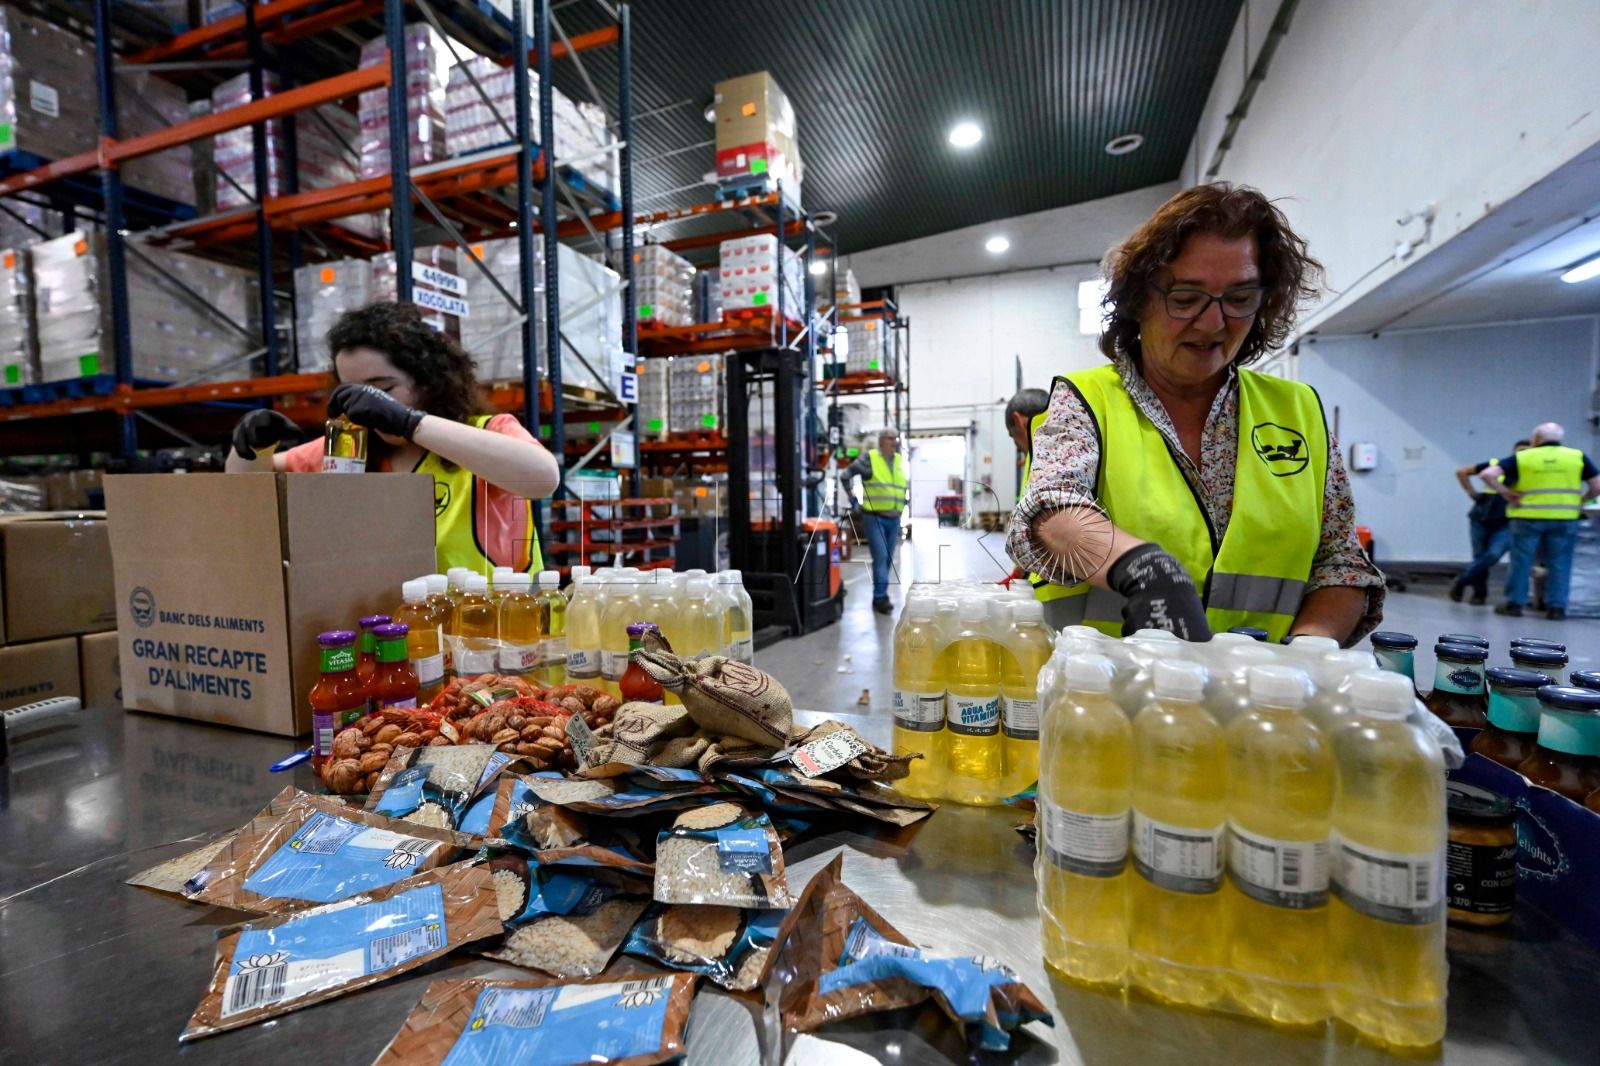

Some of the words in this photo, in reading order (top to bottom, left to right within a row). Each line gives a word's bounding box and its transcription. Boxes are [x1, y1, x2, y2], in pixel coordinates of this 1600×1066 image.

[417, 290, 466, 315] XOCOLATA
[620, 375, 635, 399] E
[159, 611, 186, 625] BANC
[188, 613, 212, 628] DELS
[213, 616, 265, 633] ALIMENTS
[132, 638, 180, 662] GRAN
[185, 644, 268, 674] RECAPTE
[328, 657, 354, 666] VITASIA
[148, 667, 252, 700] D'ALIMENTS
[961, 706, 999, 724] VITAMINA
[1519, 838, 1552, 865] elights
